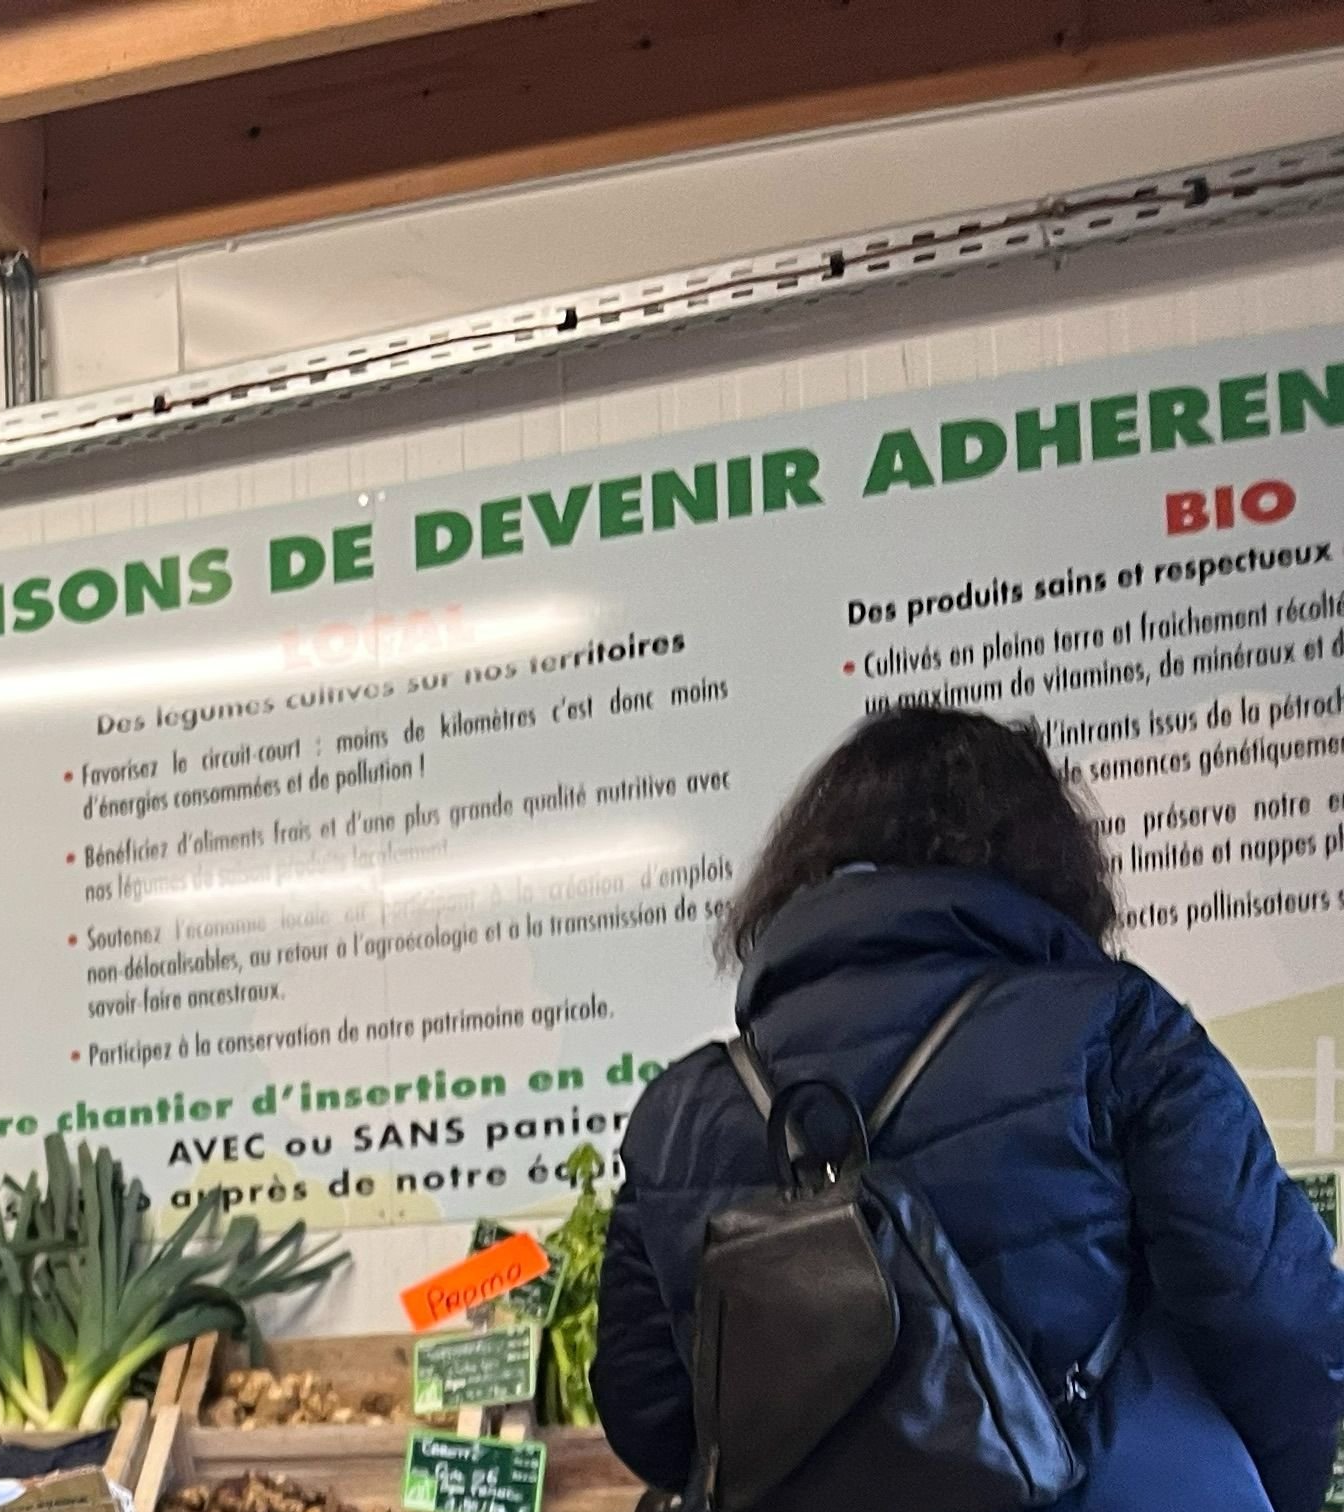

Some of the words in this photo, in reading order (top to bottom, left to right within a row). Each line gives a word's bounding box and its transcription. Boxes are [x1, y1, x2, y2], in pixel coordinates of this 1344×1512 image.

[269, 525, 372, 592] DE
[415, 447, 821, 569] DEVENIR
[1166, 479, 1296, 536] BIO
[848, 600, 897, 625] Des
[907, 581, 1023, 624] produits
[1034, 571, 1107, 599] sains
[1117, 563, 1143, 588] et
[1154, 545, 1330, 584] respectueux
[863, 647, 942, 678] Cultivés
[949, 646, 975, 666] en
[982, 634, 1046, 668] pleine
[1053, 629, 1104, 652] terre
[1112, 620, 1132, 644] et
[96, 715, 146, 736] Des
[407, 673, 449, 693] sur
[464, 663, 518, 684] nos
[81, 760, 159, 785] Favorisez
[172, 749, 188, 774] le
[335, 730, 389, 753] moins
[402, 717, 426, 743] de
[440, 709, 537, 738] kilomètres
[551, 696, 593, 722] c'est
[609, 688, 654, 714] donc
[670, 678, 729, 705] moins
[88, 1042, 172, 1066] Participez
[178, 1037, 189, 1058] à
[195, 1032, 211, 1057] la
[217, 1027, 331, 1053] conservation
[337, 1019, 359, 1043] de
[366, 1018, 414, 1040] notre
[421, 1009, 524, 1039] patrimoine
[252, 1071, 506, 1115] d'insertion
[528, 1067, 584, 1092] en
[167, 1133, 265, 1165] AVEC
[285, 1137, 332, 1157] ou
[353, 1117, 465, 1152] SANS
[328, 1168, 375, 1198] de
[396, 1166, 507, 1192] notre
